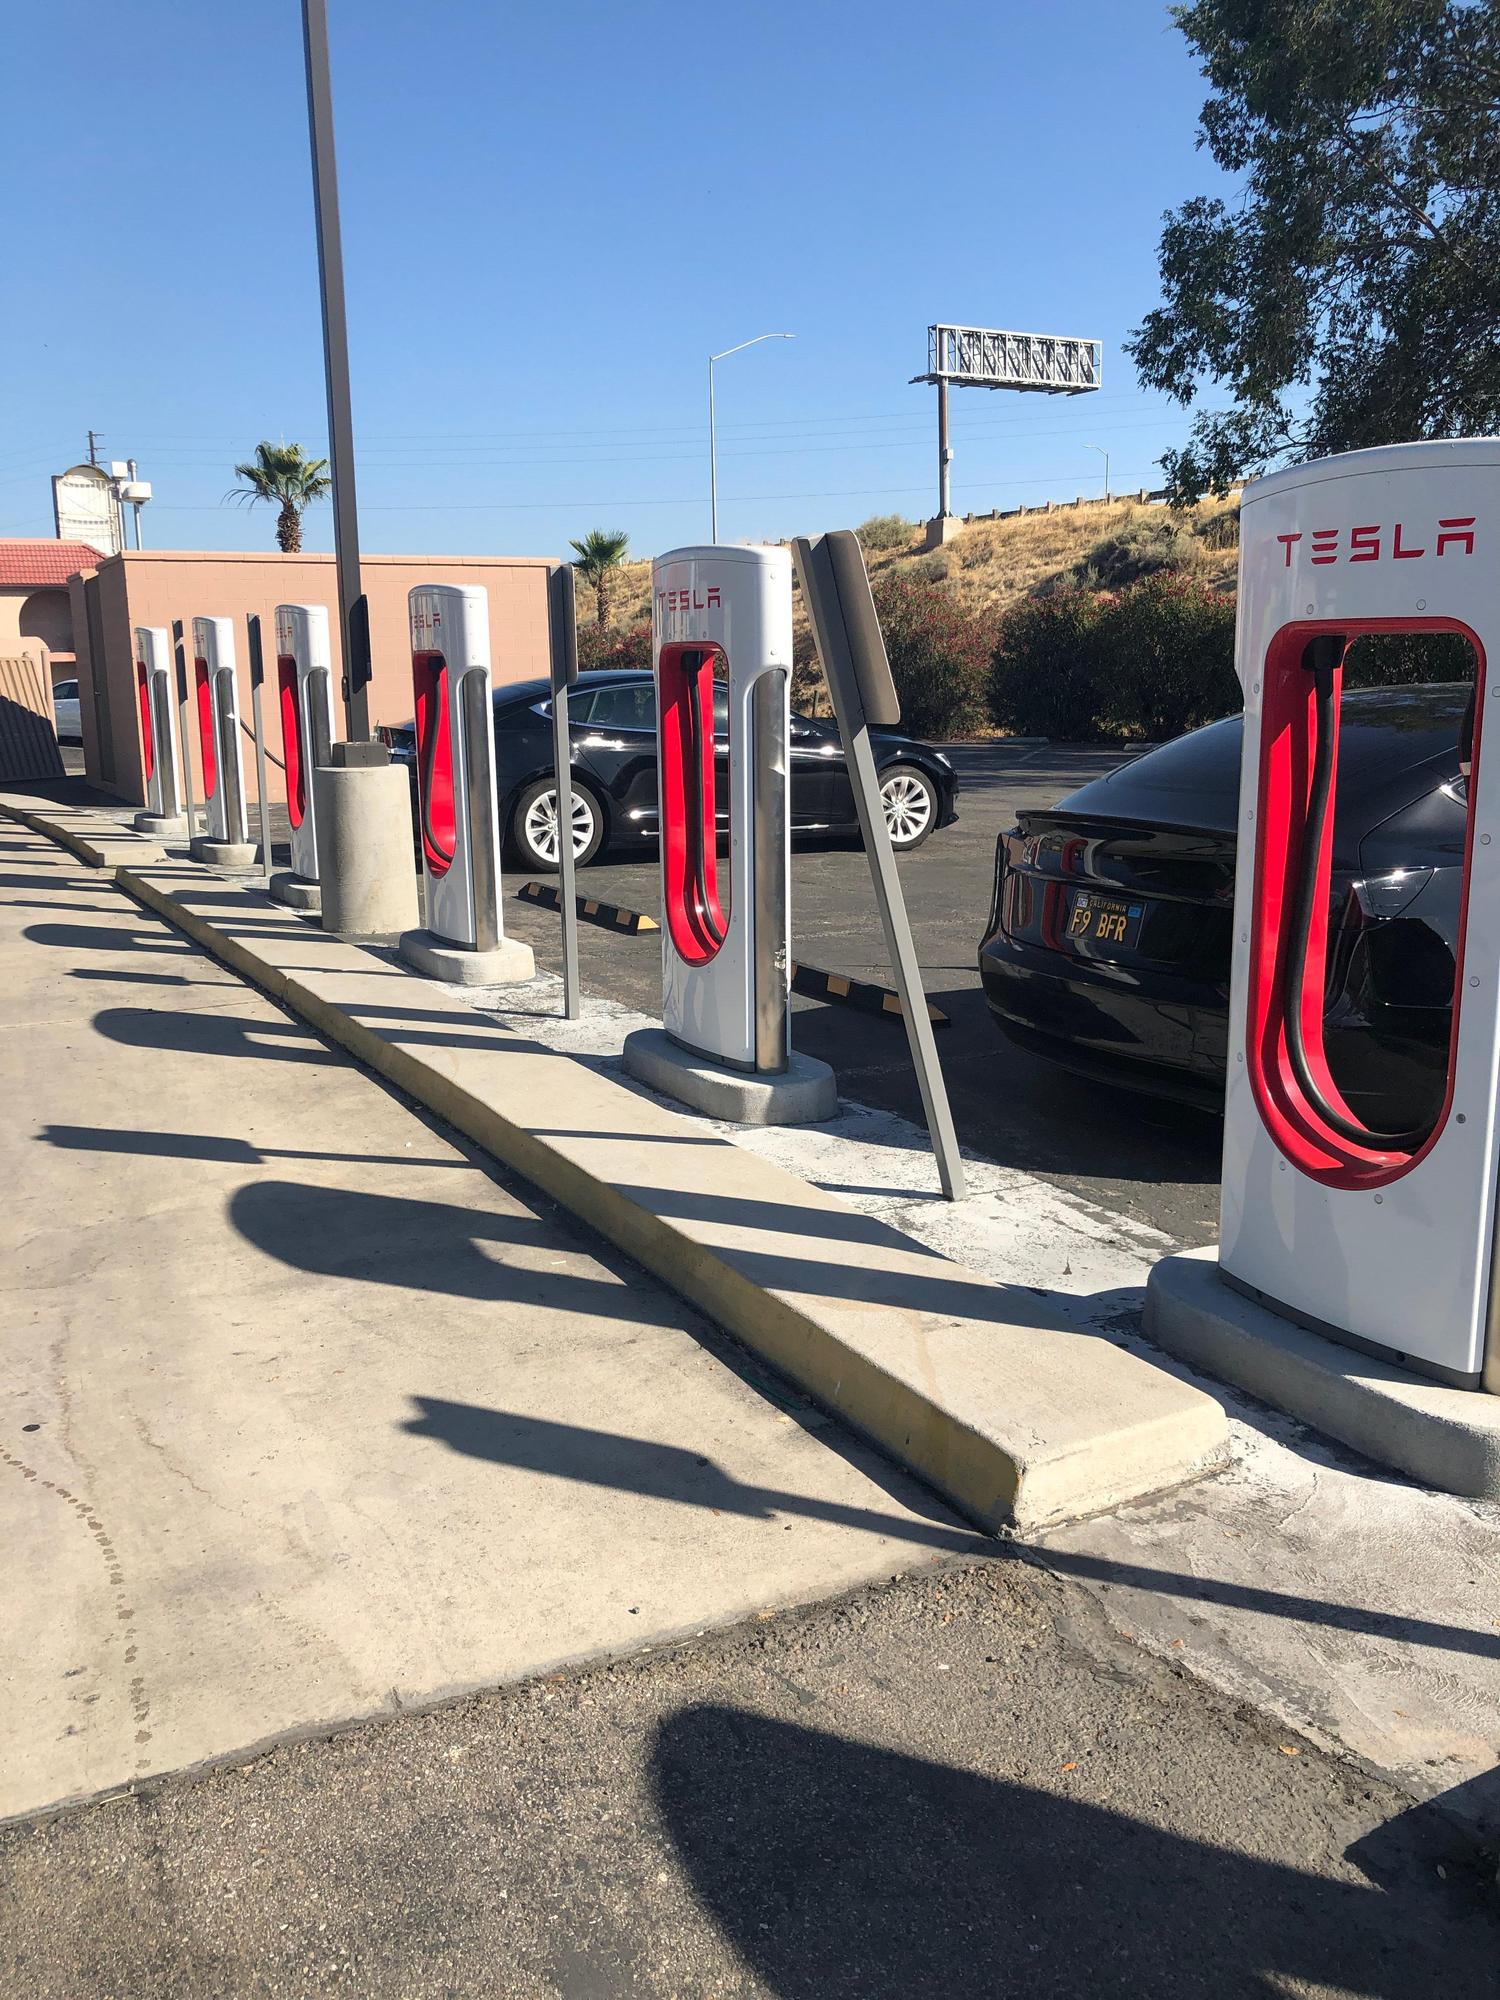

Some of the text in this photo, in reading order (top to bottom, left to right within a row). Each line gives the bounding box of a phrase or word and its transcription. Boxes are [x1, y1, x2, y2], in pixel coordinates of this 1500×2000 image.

[1276, 517, 1476, 567] TESLA
[659, 587, 721, 612] TESLA
[1089, 900, 1127, 913] CALIFORNIA
[1070, 908, 1127, 942] F9 BFR
